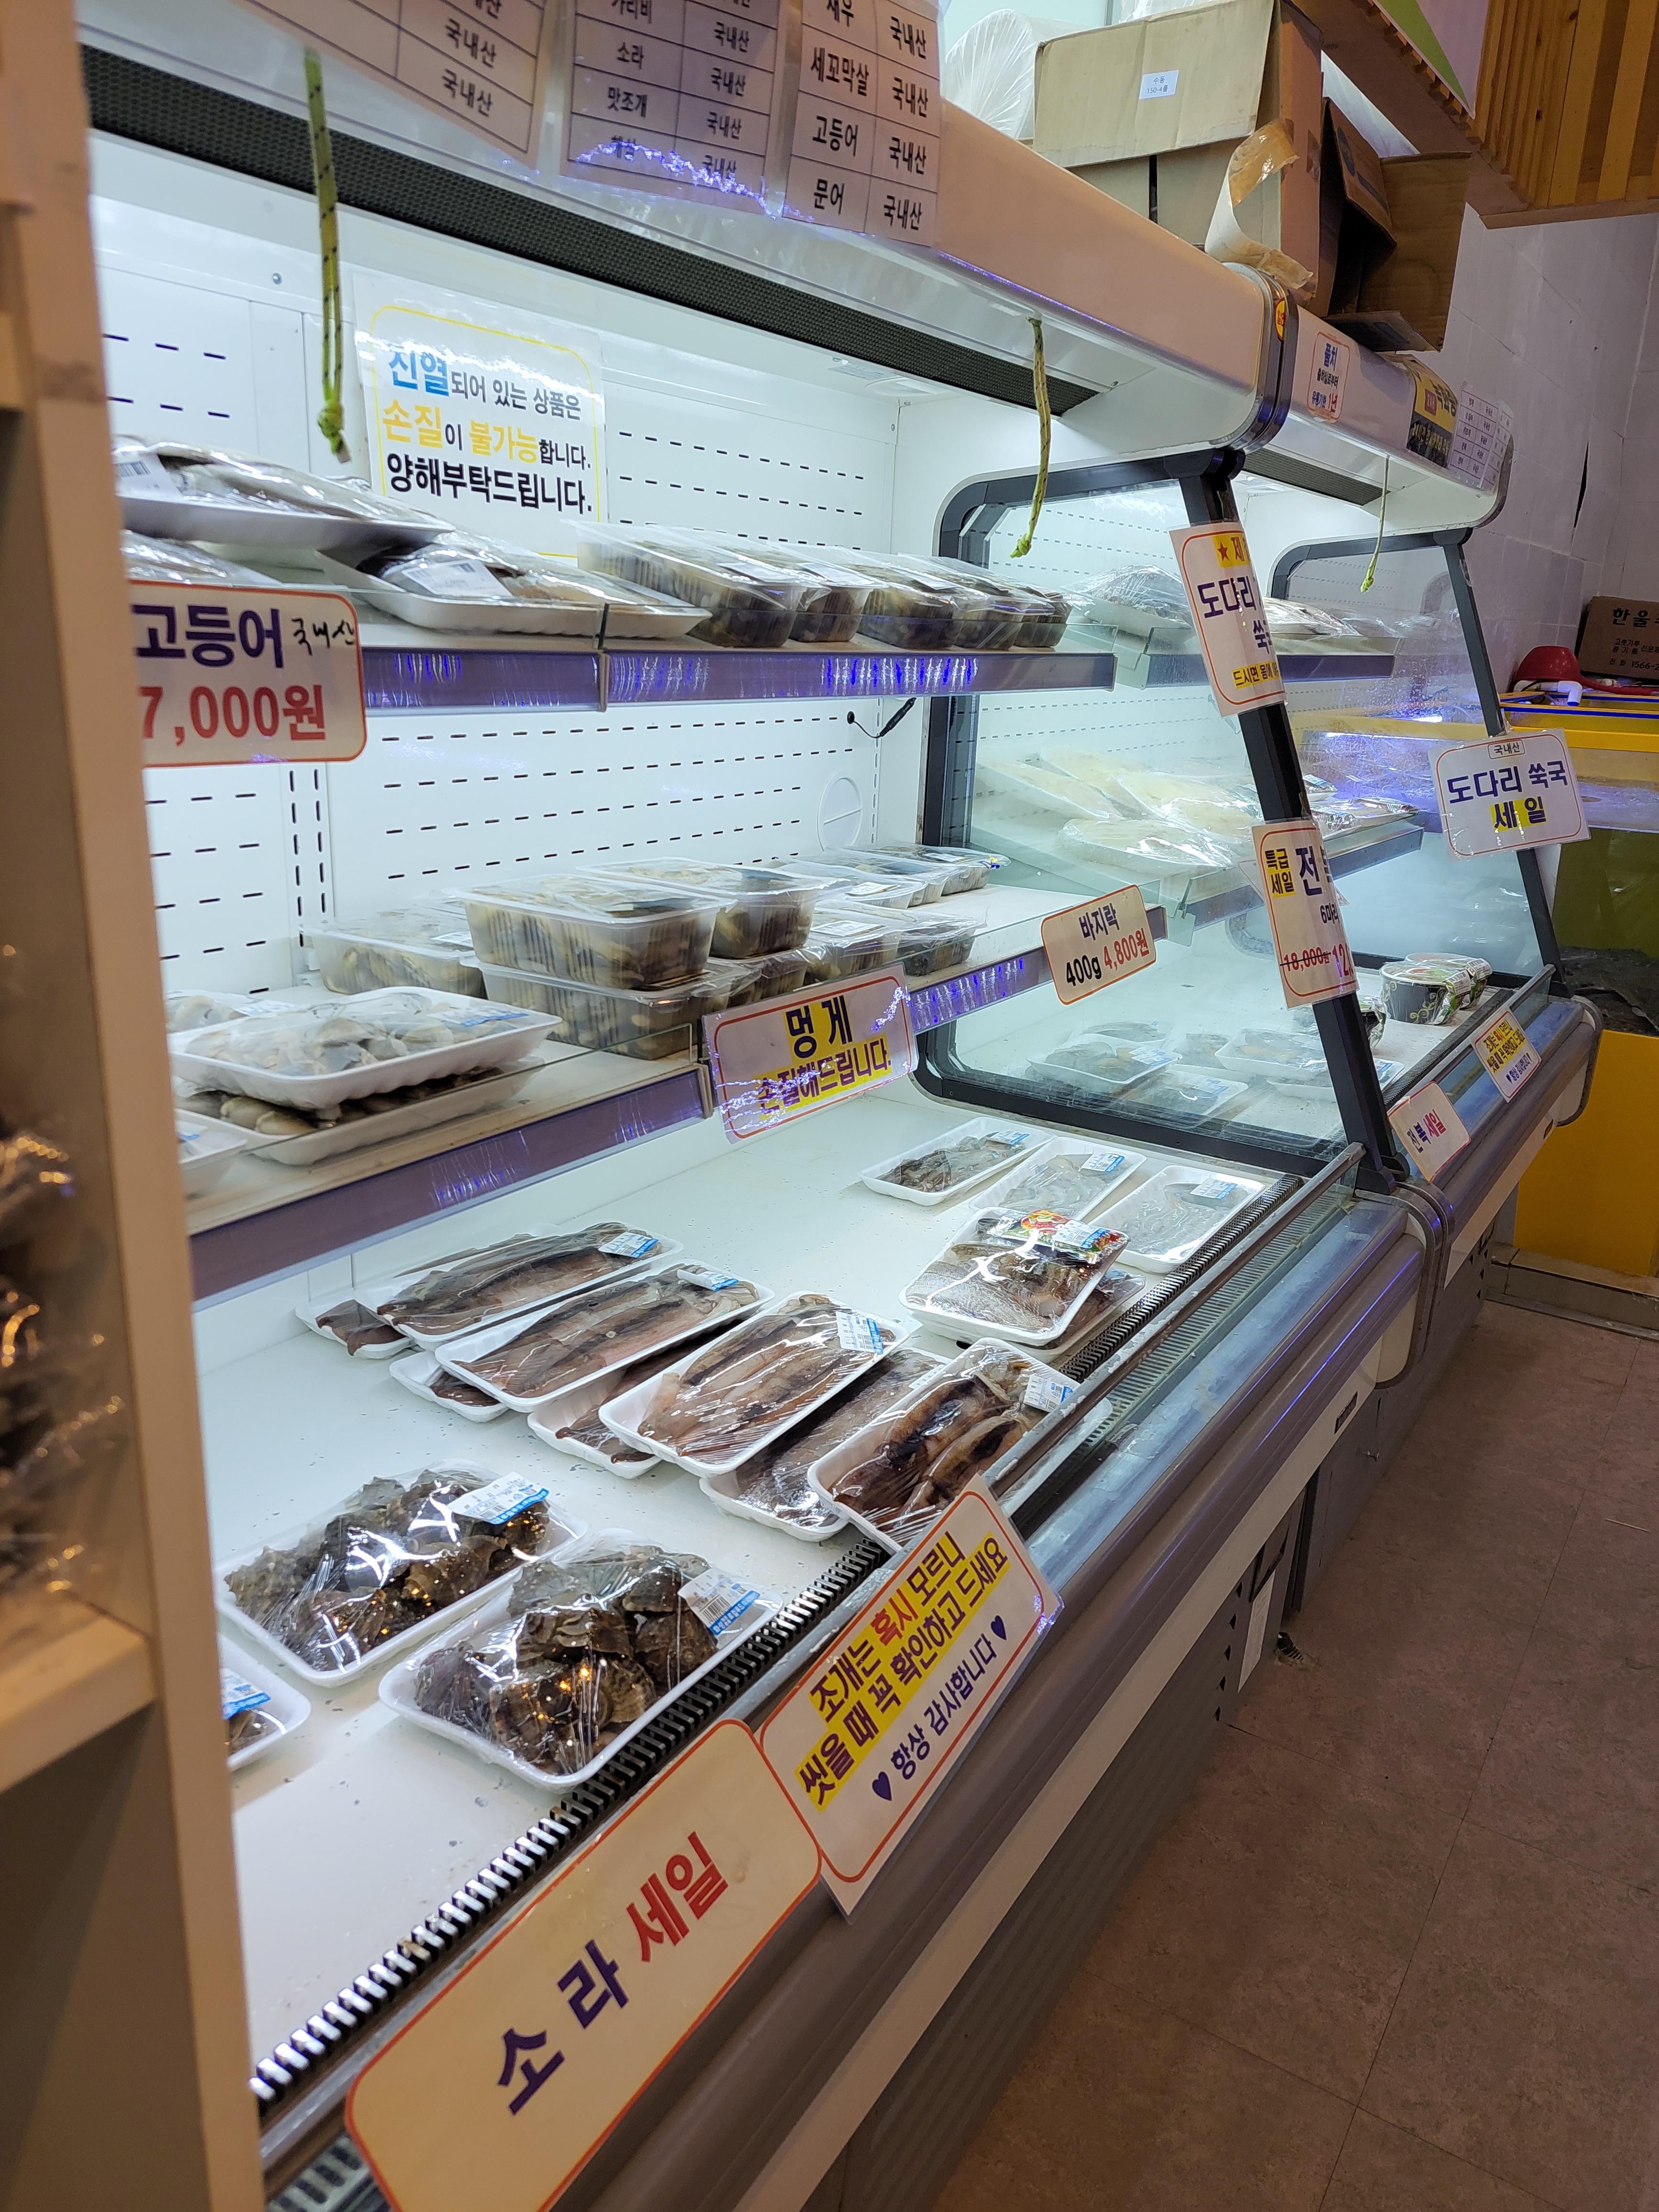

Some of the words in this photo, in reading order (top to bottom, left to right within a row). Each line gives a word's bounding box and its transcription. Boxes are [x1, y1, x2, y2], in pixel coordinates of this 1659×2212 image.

[444, 17, 497, 68] 국내산
[714, 22, 750, 53] 국내산
[890, 15, 926, 60] 국내산
[617, 41, 644, 70] 소라
[711, 67, 746, 97] 국내산
[810, 46, 869, 97] 세꼬막살
[892, 77, 929, 119] 국내산
[1153, 76, 1166, 85] 수동
[442, 68, 493, 118] 국내산
[607, 86, 648, 118] 맛조개
[707, 111, 742, 140] 국내산
[812, 115, 859, 157] 고등어
[889, 136, 927, 175] 국내산
[814, 178, 845, 216] 문어
[884, 194, 922, 231] 국내산
[493, 378, 527, 410] 있는
[533, 387, 582, 420] 상품은
[382, 398, 464, 451] 손질이
[469, 419, 592, 471] 불가능합니다.
[387, 453, 593, 515] 양해부탁드립니다.
[1230, 536, 1250, 563] 제
[1197, 575, 1257, 619] 도다리
[132, 603, 284, 668] 고등어
[291, 618, 355, 656] 국내산
[1252, 619, 1273, 654] 쑥
[1233, 663, 1261, 686] 드시면
[138, 685, 326, 747] 7,000원
[1493, 742, 1520, 755] 국내산
[1447, 766, 1523, 804] 도다리
[1528, 760, 1568, 788] 쑥국
[1494, 796, 1547, 829] 세일
[1264, 847, 1290, 871] 특급
[1270, 871, 1295, 895] 세일
[1078, 902, 1120, 941] 바지락
[1320, 903, 1339, 925] 6마리
[1066, 955, 1102, 987] 400g
[1103, 928, 1150, 971] 4,800원
[785, 995, 853, 1059] 멍게
[1483, 1035, 1499, 1052] 조개는
[1493, 1028, 1506, 1041] 혹시
[1499, 1019, 1514, 1037] 모르니
[1486, 1055, 1500, 1073] 씻을
[1509, 1067, 1520, 1082] 항상
[1515, 1054, 1531, 1075] 감사합니다
[1406, 1121, 1432, 1154] 전복
[1423, 1108, 1447, 1138] 세일
[809, 1637, 882, 1723] 조개는
[870, 1587, 919, 1648] 혹시
[906, 1530, 966, 1608] 모르니
[798, 1732, 856, 1806] 씻을
[842, 1700, 879, 1747] 때
[868, 1679, 903, 1714] 꼭
[889, 1594, 966, 1688] 확인하고
[955, 1537, 1010, 1608] 드세요
[889, 1723, 930, 1781] 항상
[923, 1632, 997, 1736] 감사합니다
[497, 1939, 630, 2117] 소라
[626, 1830, 730, 1964] 세일
